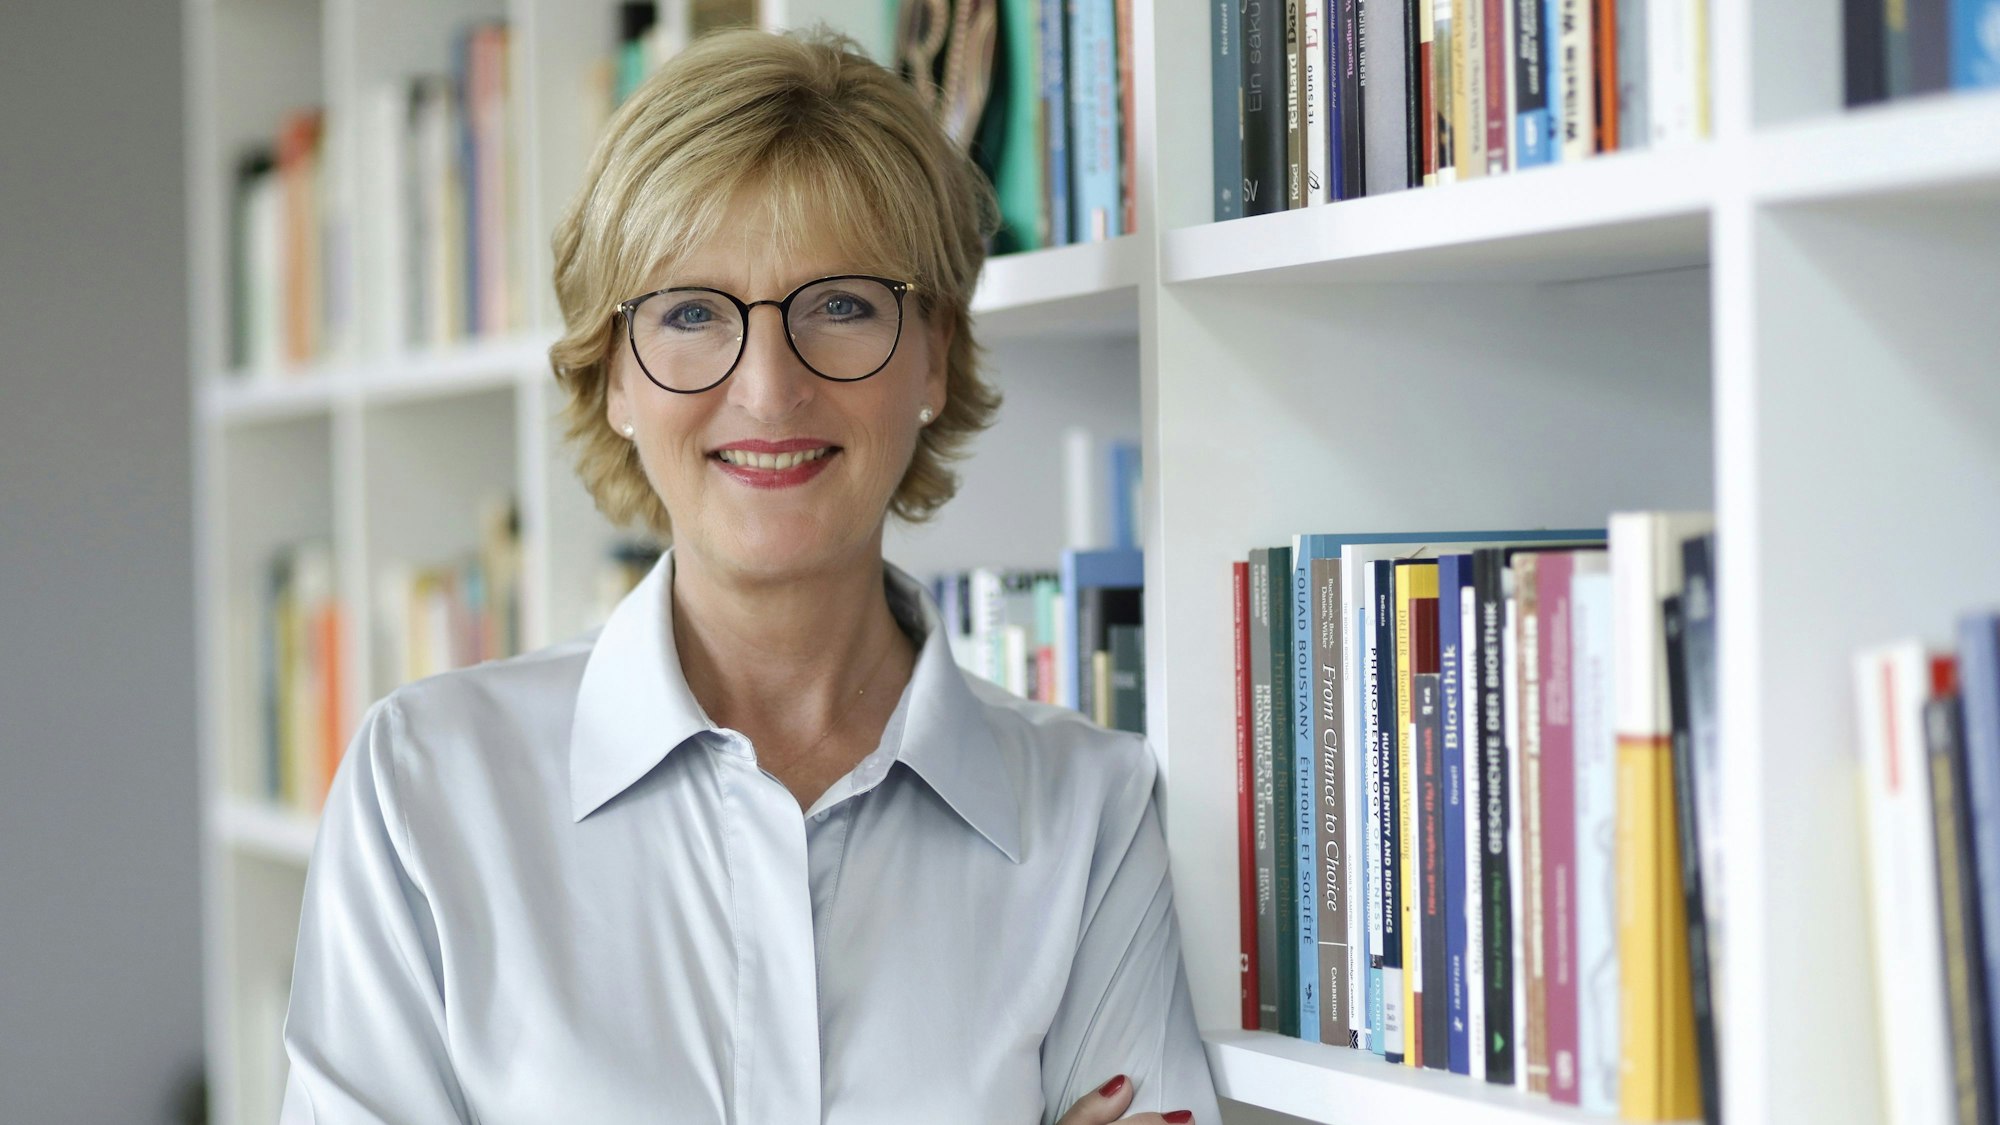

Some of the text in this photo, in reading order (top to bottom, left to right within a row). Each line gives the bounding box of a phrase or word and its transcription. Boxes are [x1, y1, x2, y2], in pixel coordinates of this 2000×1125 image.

[1248, 0, 1262, 112] Ein säku
[1287, 2, 1298, 134] Teilhard Das
[1565, 46, 1577, 143] Wilhelm
[1243, 178, 1259, 202] SV
[1290, 163, 1299, 200] Kösel
[1399, 609, 1407, 656] DREIER
[1275, 652, 1286, 741] Principles
[1371, 647, 1380, 819] PHENOMENOLOGY
[1400, 669, 1409, 716] Bioethik
[1443, 643, 1458, 749] Bioethik
[1483, 601, 1502, 855] GESCHICHTE DER BIOETHIK
[1256, 684, 1266, 850] BIOMEDICAL ETHICS
[1263, 684, 1273, 805] PRINCIPLES OF
[1297, 567, 1313, 945] FOUAD BOUSTANY ÉTHIQUE ET SOCIÉTÉ
[1322, 663, 1340, 911] From Chance to Choice
[1401, 732, 1409, 765] Politik
[1402, 772, 1410, 795] und
[1373, 828, 1380, 850] OF
[1382, 732, 1393, 934] HUMAN IDENTITY AND BIOETHICS
[1400, 798, 1410, 860] Verfassung
